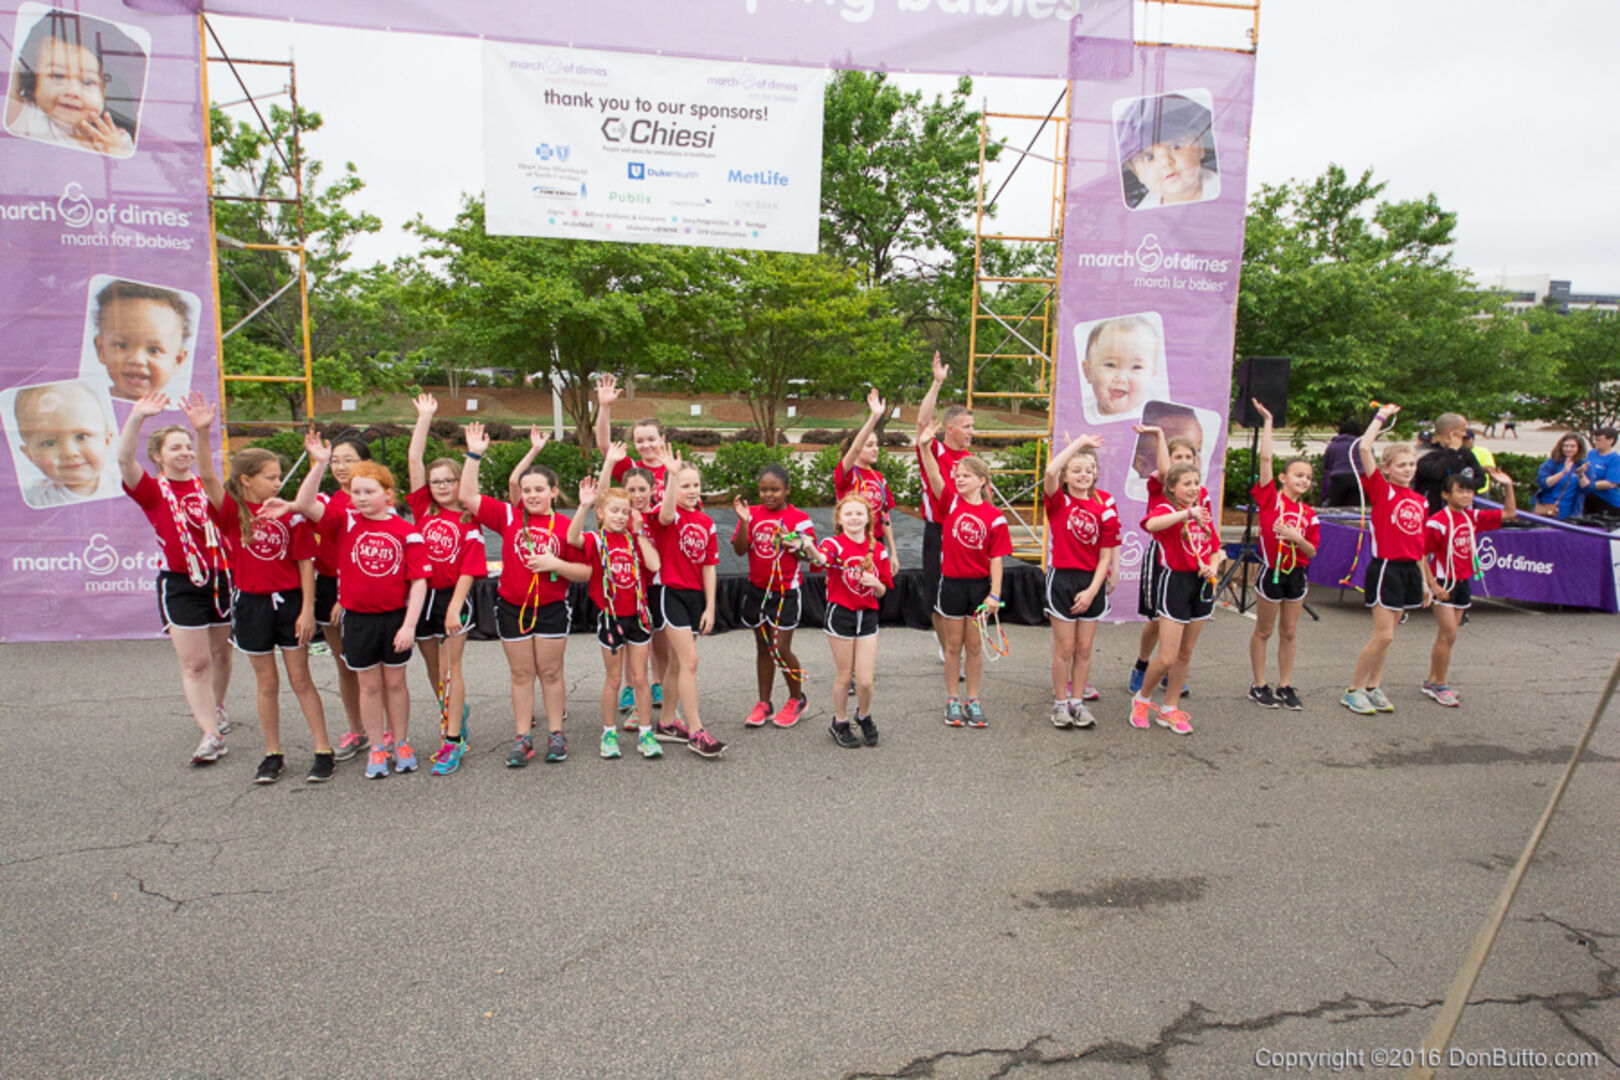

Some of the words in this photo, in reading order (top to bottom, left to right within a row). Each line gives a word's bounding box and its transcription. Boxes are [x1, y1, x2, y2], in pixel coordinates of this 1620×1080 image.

[509, 60, 544, 72] march
[562, 64, 574, 73] of
[575, 65, 608, 77] dimes
[706, 76, 739, 88] march
[755, 80, 767, 90] of
[768, 80, 798, 92] dimes
[544, 88, 594, 109] thank
[599, 98, 630, 113] you
[635, 97, 652, 112] to
[657, 101, 685, 116] our
[690, 103, 768, 121] sponsors!
[630, 118, 716, 149] Chiesi
[647, 168, 699, 178] DukeHealth
[727, 169, 789, 187] MetLife
[609, 192, 651, 204] Publix
[0, 201, 57, 222] arch
[95, 203, 116, 223] of
[119, 204, 190, 228] dimes
[61, 232, 109, 246] march
[112, 232, 132, 247] for
[135, 231, 191, 250] babies
[1078, 251, 1135, 268] march
[1163, 253, 1180, 270] of
[1180, 254, 1228, 273] dimes
[1134, 276, 1170, 289] march
[1172, 276, 1187, 290] for
[1188, 277, 1224, 293] babies
[13, 553, 82, 571] march
[121, 552, 145, 570] of
[1497, 554, 1513, 570] of
[1513, 556, 1553, 574] dimes
[85, 578, 135, 591] march
